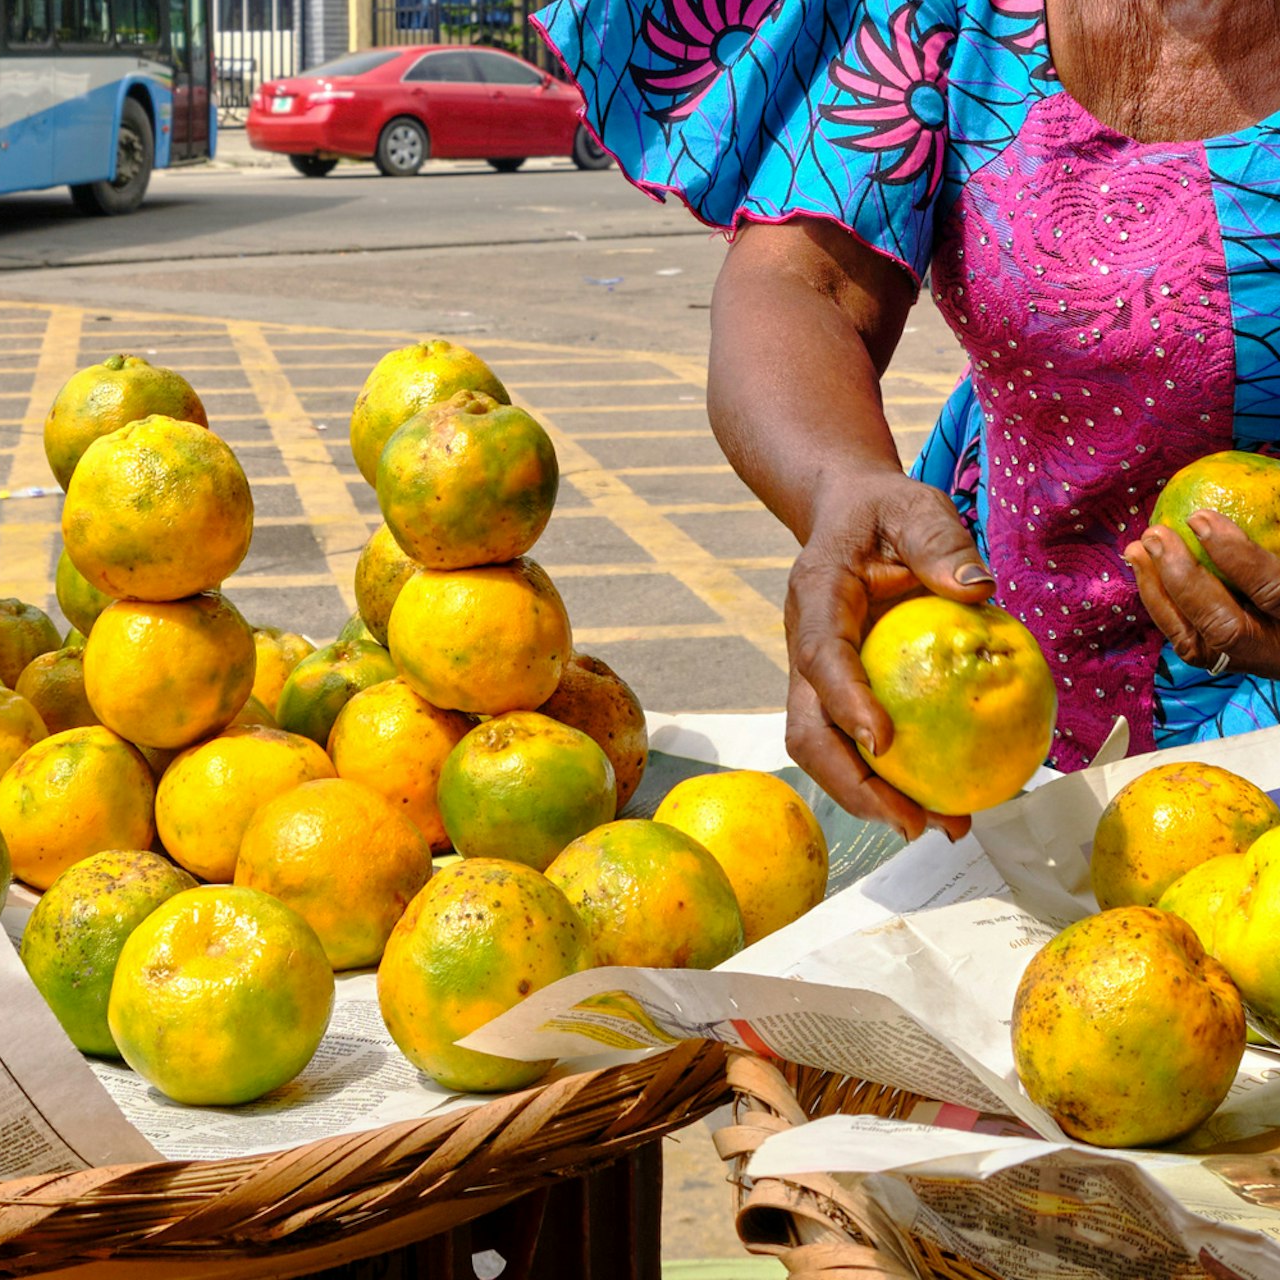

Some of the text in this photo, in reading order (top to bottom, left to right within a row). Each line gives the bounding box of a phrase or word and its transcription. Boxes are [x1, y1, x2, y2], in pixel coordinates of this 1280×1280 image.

[1008, 937, 1031, 948] 2019
[1007, 1169, 1026, 1180] the
[1055, 1216, 1078, 1227] that
